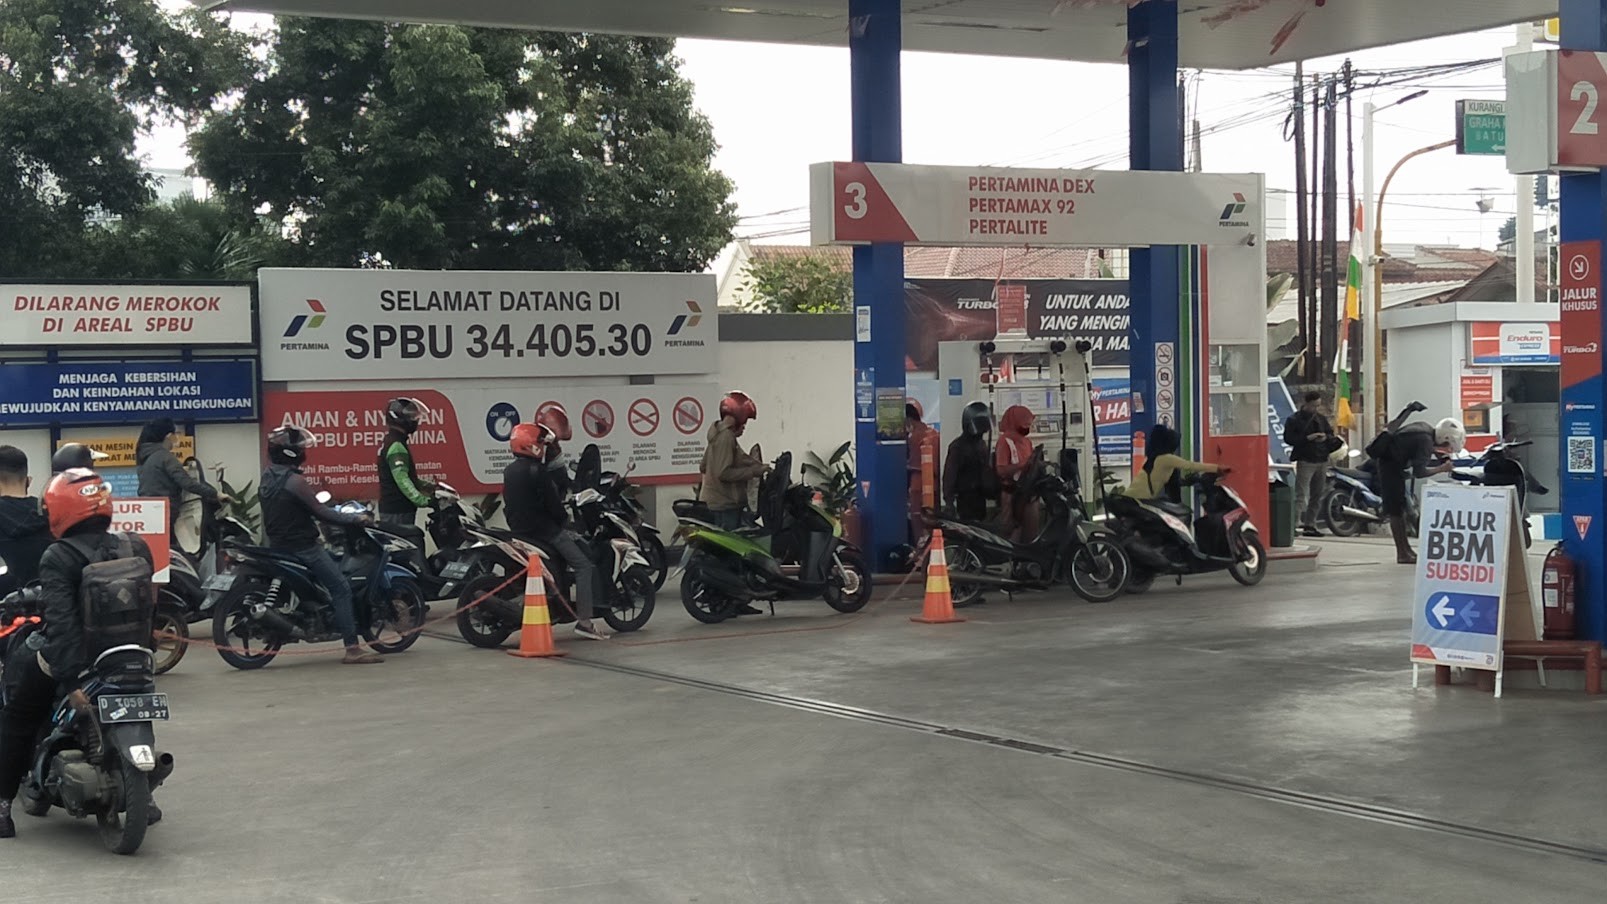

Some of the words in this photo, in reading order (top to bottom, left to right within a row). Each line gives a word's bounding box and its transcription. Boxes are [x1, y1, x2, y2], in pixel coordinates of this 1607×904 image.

[1468, 102, 1504, 113] KURANGI
[1569, 80, 1599, 135] 2
[1468, 117, 1500, 128] GRAHA
[968, 176, 1060, 193] PERTAMINA
[1062, 178, 1095, 194] DEX
[844, 181, 868, 219] 3
[968, 198, 1052, 214] PERTAMAX
[1056, 200, 1075, 214] 92
[968, 219, 1048, 235] PERTALITE
[380, 289, 492, 311] SELAMAT
[500, 290, 592, 311] DATANG
[599, 291, 620, 311] DI
[1562, 287, 1597, 300] JALUR
[14, 296, 121, 312] DILARANG
[126, 296, 221, 311] MEROKOK
[1045, 294, 1094, 310] UNTUK
[1562, 301, 1598, 312] KHUSUS
[42, 317, 64, 332] DI
[73, 317, 133, 332] AREAL
[145, 317, 194, 332] SPBU
[1039, 315, 1078, 331] YANG
[280, 342, 330, 350] PERTAMINA
[345, 323, 454, 359] SPBU
[466, 323, 652, 359] 34.405.30
[1106, 336, 1130, 351] MA
[59, 373, 118, 384] MENJAGA
[124, 371, 197, 384] KEBERSIHAN
[53, 387, 80, 398] DAN
[83, 386, 155, 398] KEINDAHAN
[158, 385, 201, 396] LOKASI
[83, 400, 170, 413] KENYAMANAN
[173, 398, 252, 411] LINGKUNGAN
[1105, 401, 1131, 421] HA
[281, 410, 339, 428] AMAN
[345, 410, 359, 427] &
[365, 408, 444, 427] NYAN
[105, 442, 134, 452] MESIN
[318, 463, 379, 474] Rambu-Ramb
[350, 475, 380, 485] Kesela
[1430, 509, 1496, 532] JALUR
[1426, 531, 1495, 564] BBM
[1425, 562, 1494, 583] SUBSIDI
[100, 697, 108, 709] D
